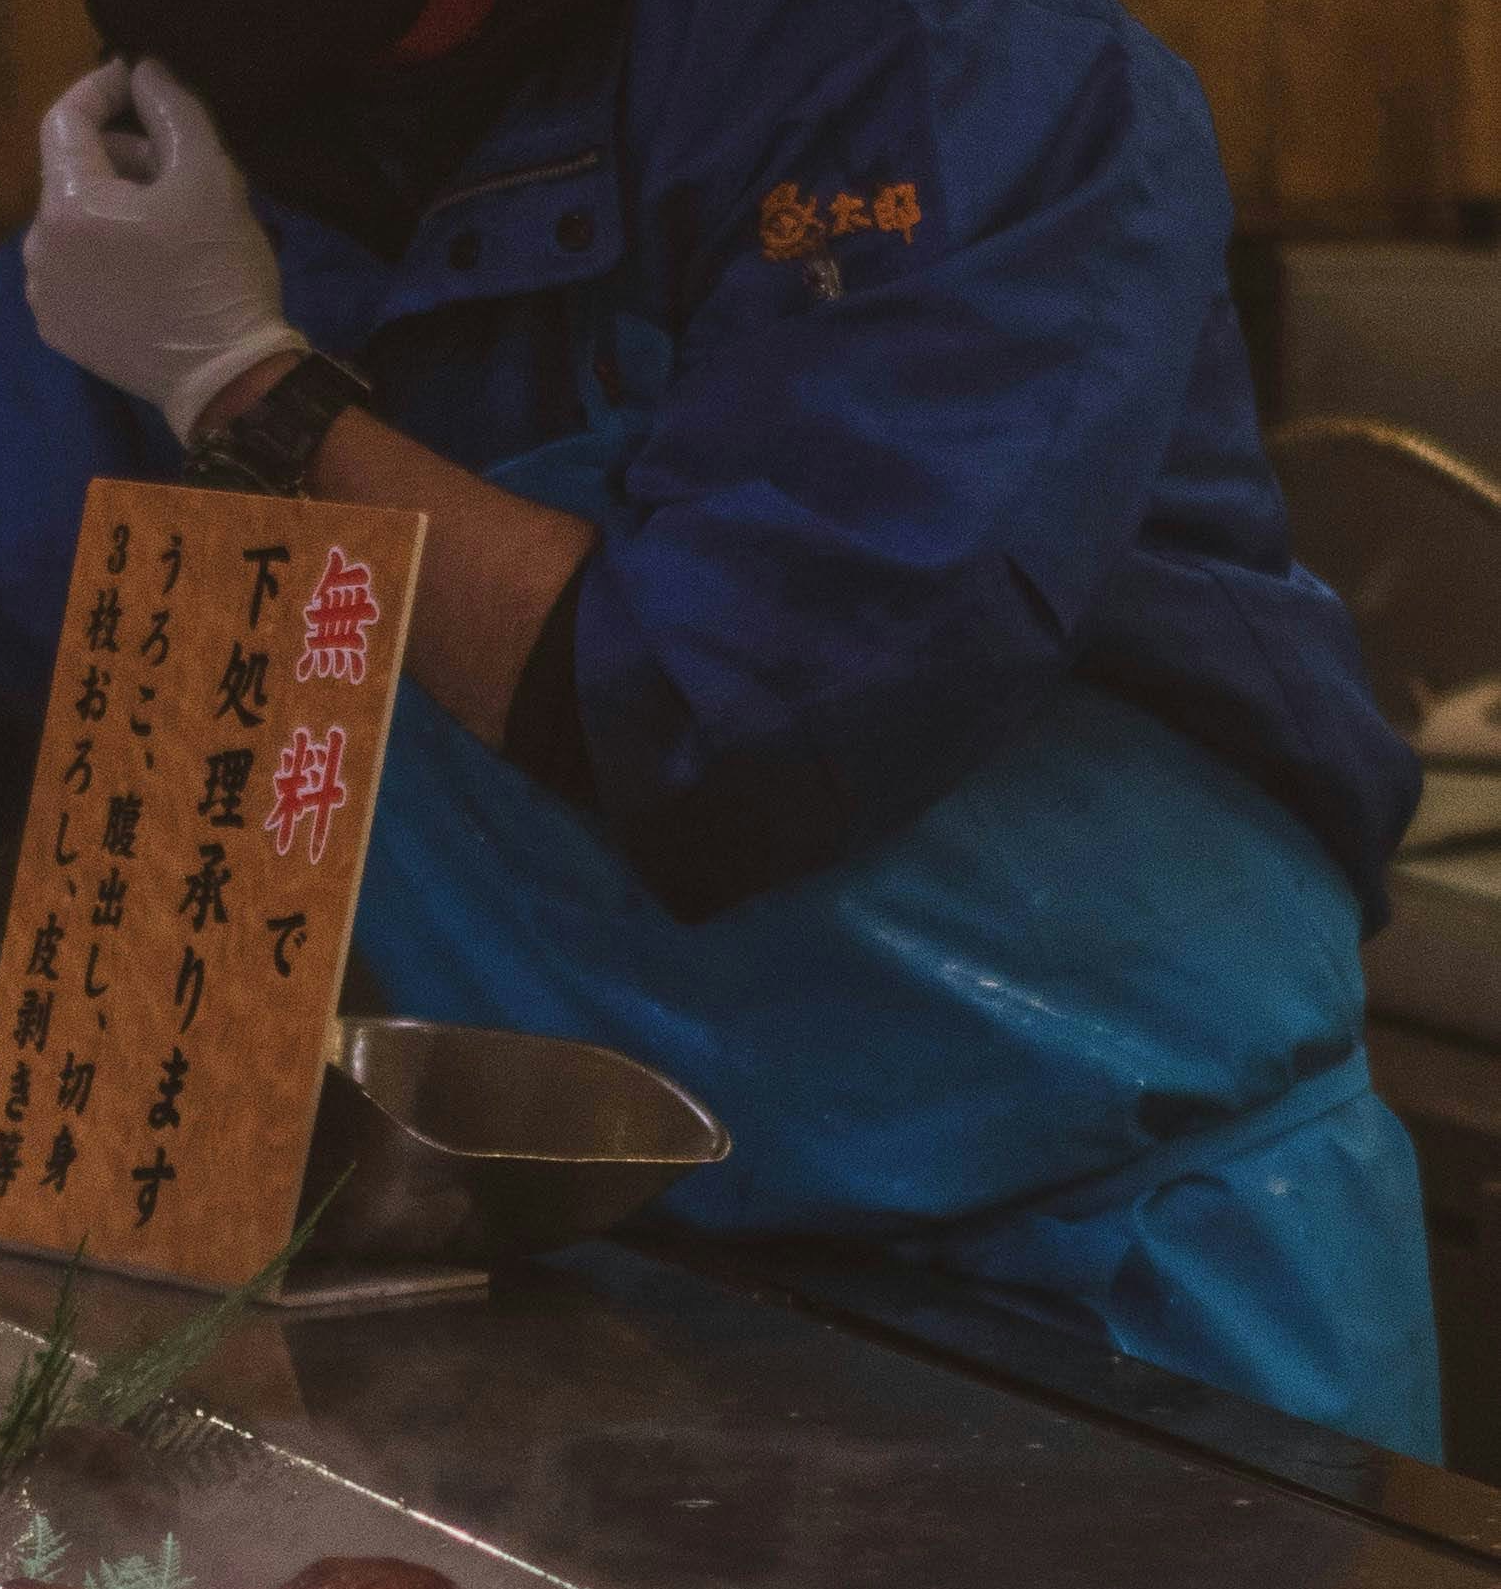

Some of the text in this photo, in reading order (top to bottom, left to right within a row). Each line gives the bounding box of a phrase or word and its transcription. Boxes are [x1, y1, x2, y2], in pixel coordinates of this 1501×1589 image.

[132, 545, 290, 1228] 下処理承ります
